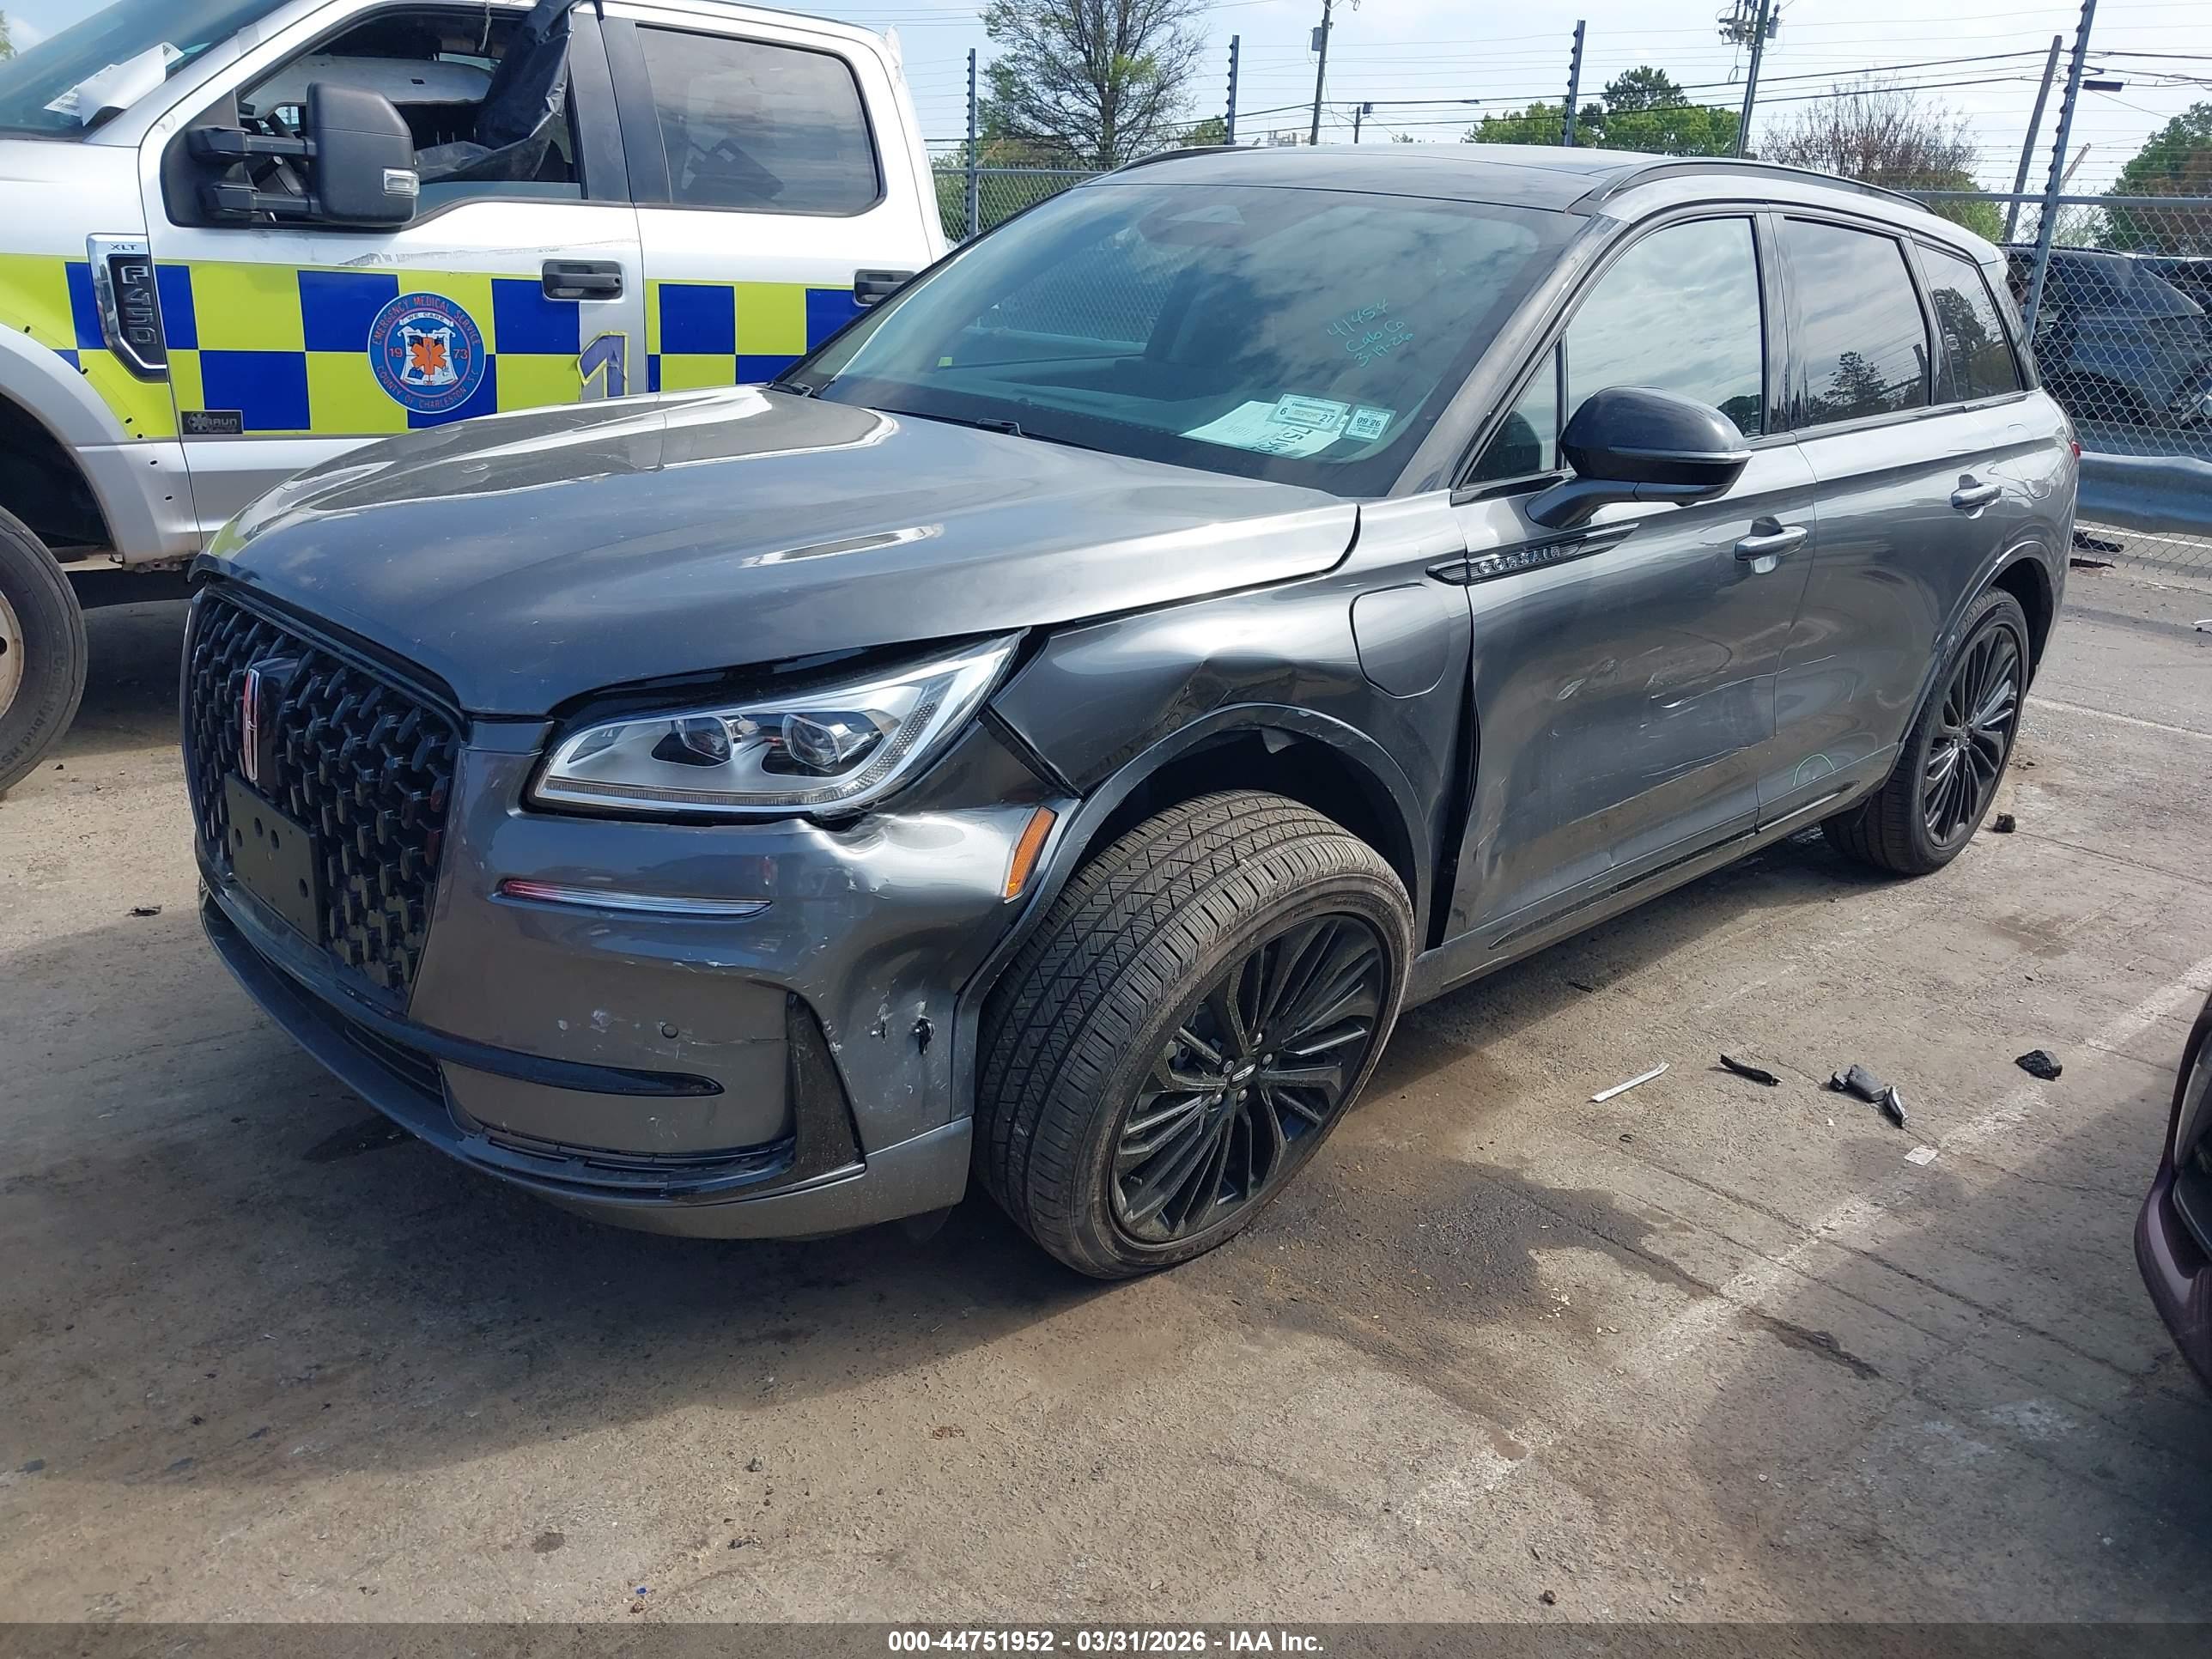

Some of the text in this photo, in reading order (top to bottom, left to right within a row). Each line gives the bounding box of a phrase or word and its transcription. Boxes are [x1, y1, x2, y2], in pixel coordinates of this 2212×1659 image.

[372, 296, 481, 346] EMERGENCY MEDICAL SERVICE
[423, 313, 445, 322] CARE
[1327, 298, 1389, 336] 41454
[389, 347, 403, 358] 19
[453, 349, 468, 359] 73
[377, 365, 404, 395] COUNTY
[404, 395, 414, 404] OF
[418, 386, 467, 409] CHARLESTON
[1279, 407, 1288, 416] 6
[1319, 414, 1335, 423] 27
[1478, 545, 1560, 574] CORSAIR
